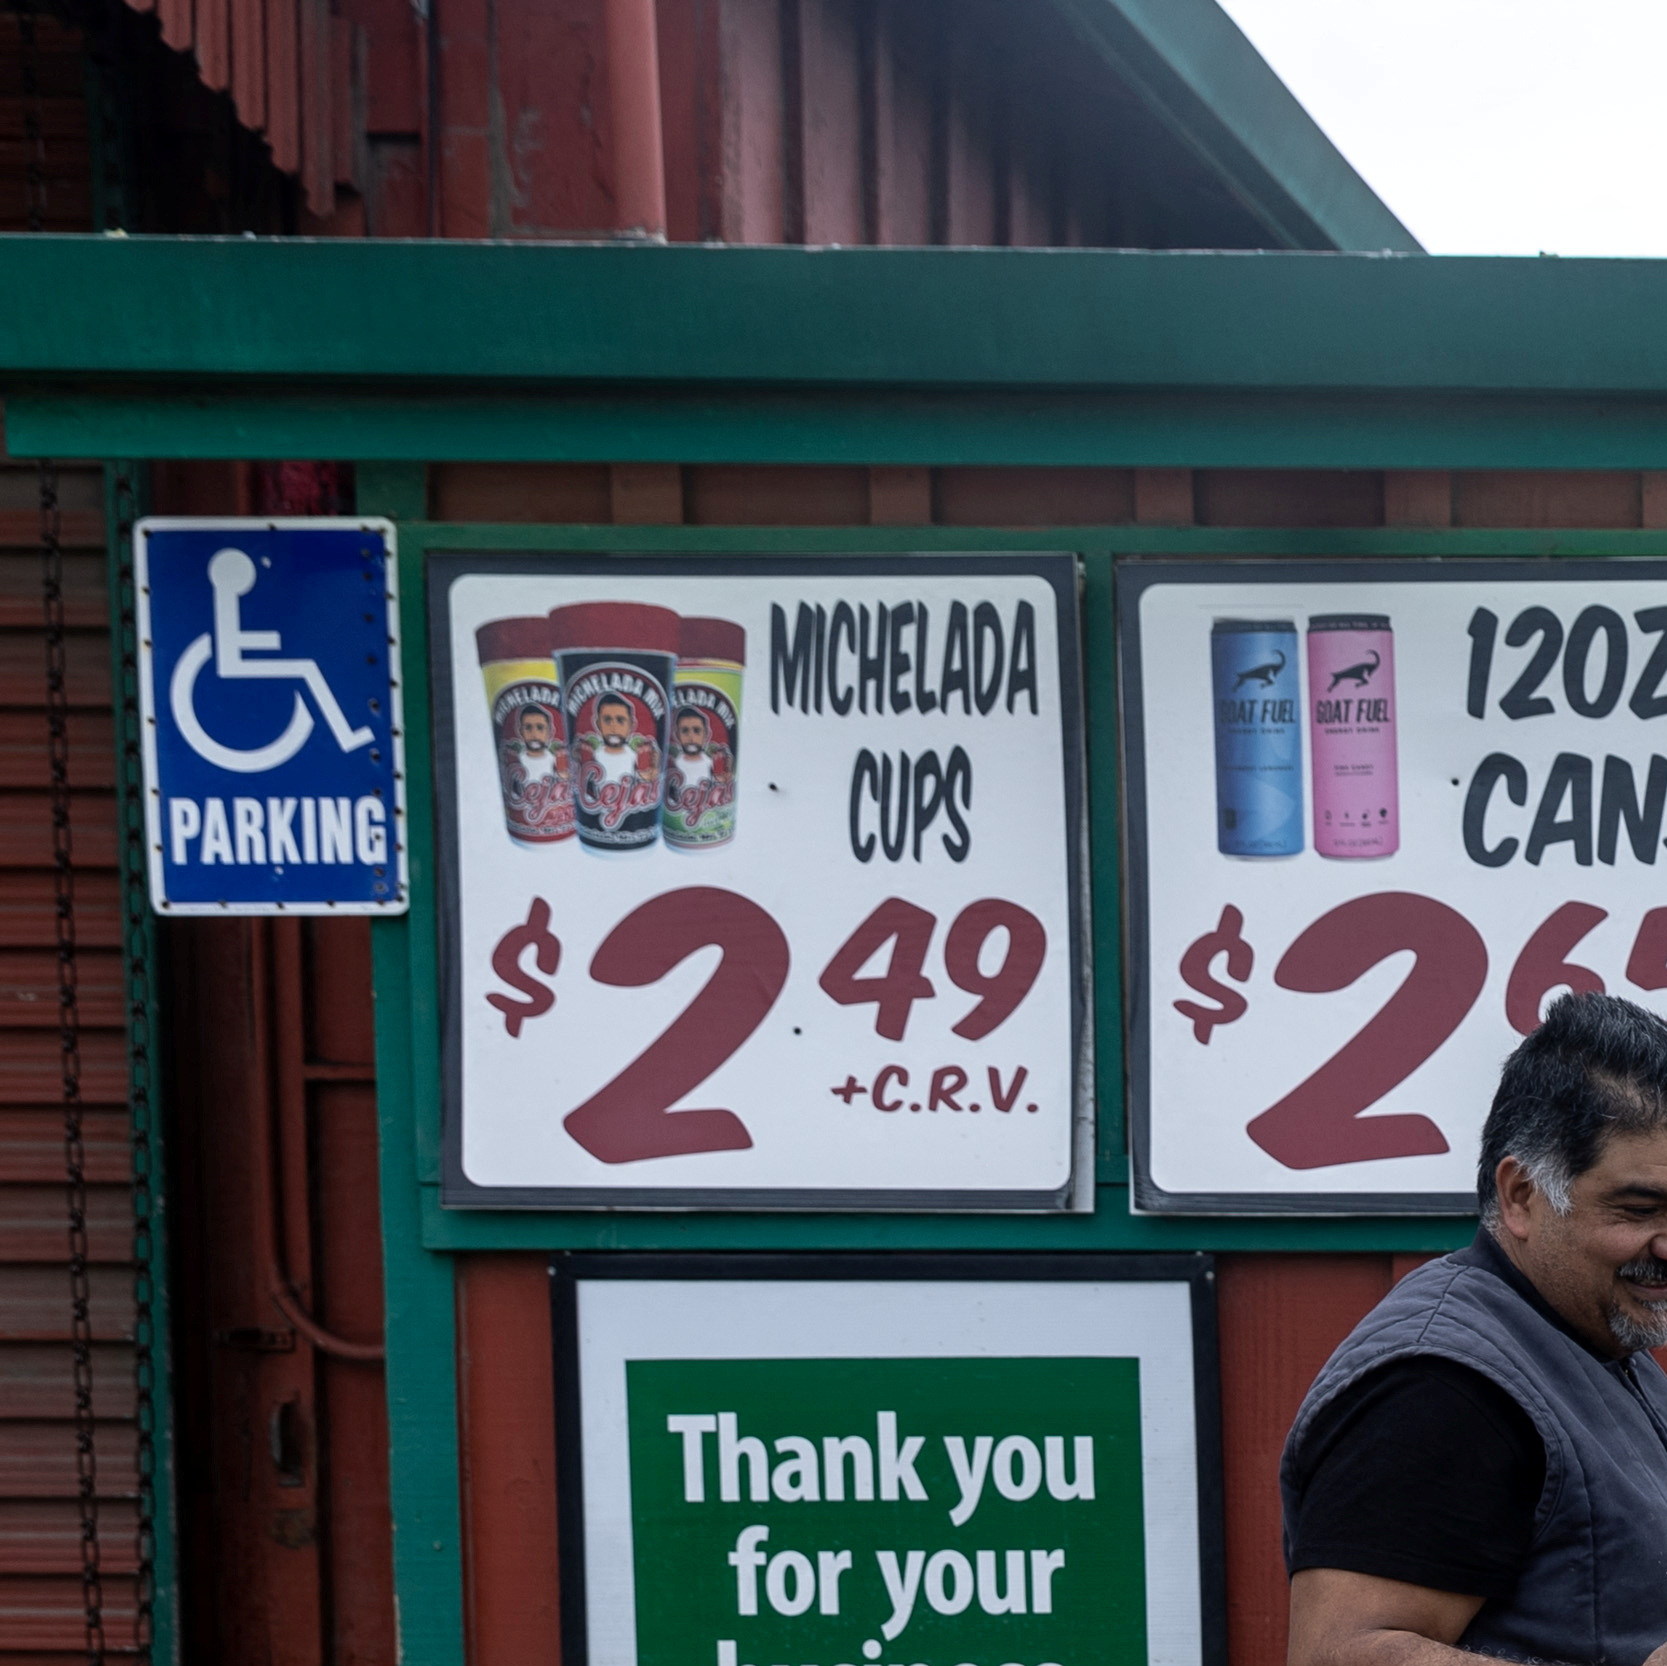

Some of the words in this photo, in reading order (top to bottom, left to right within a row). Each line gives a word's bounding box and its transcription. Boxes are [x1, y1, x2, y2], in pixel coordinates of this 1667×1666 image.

[770, 600, 1038, 716] MICHELADA
[567, 672, 643, 717] MICHELADA
[1261, 699, 1296, 723] FUEL
[1317, 699, 1355, 724] GOAT
[1357, 698, 1391, 723] FUEL
[172, 796, 388, 865] PARKING
[849, 745, 972, 863] CUPS
[831, 1066, 1039, 1113] +C.R.V.
[667, 1411, 928, 1502] Thank
[944, 1435, 1095, 1526] you
[728, 1525, 852, 1616] for
[876, 1549, 1065, 1641] your
